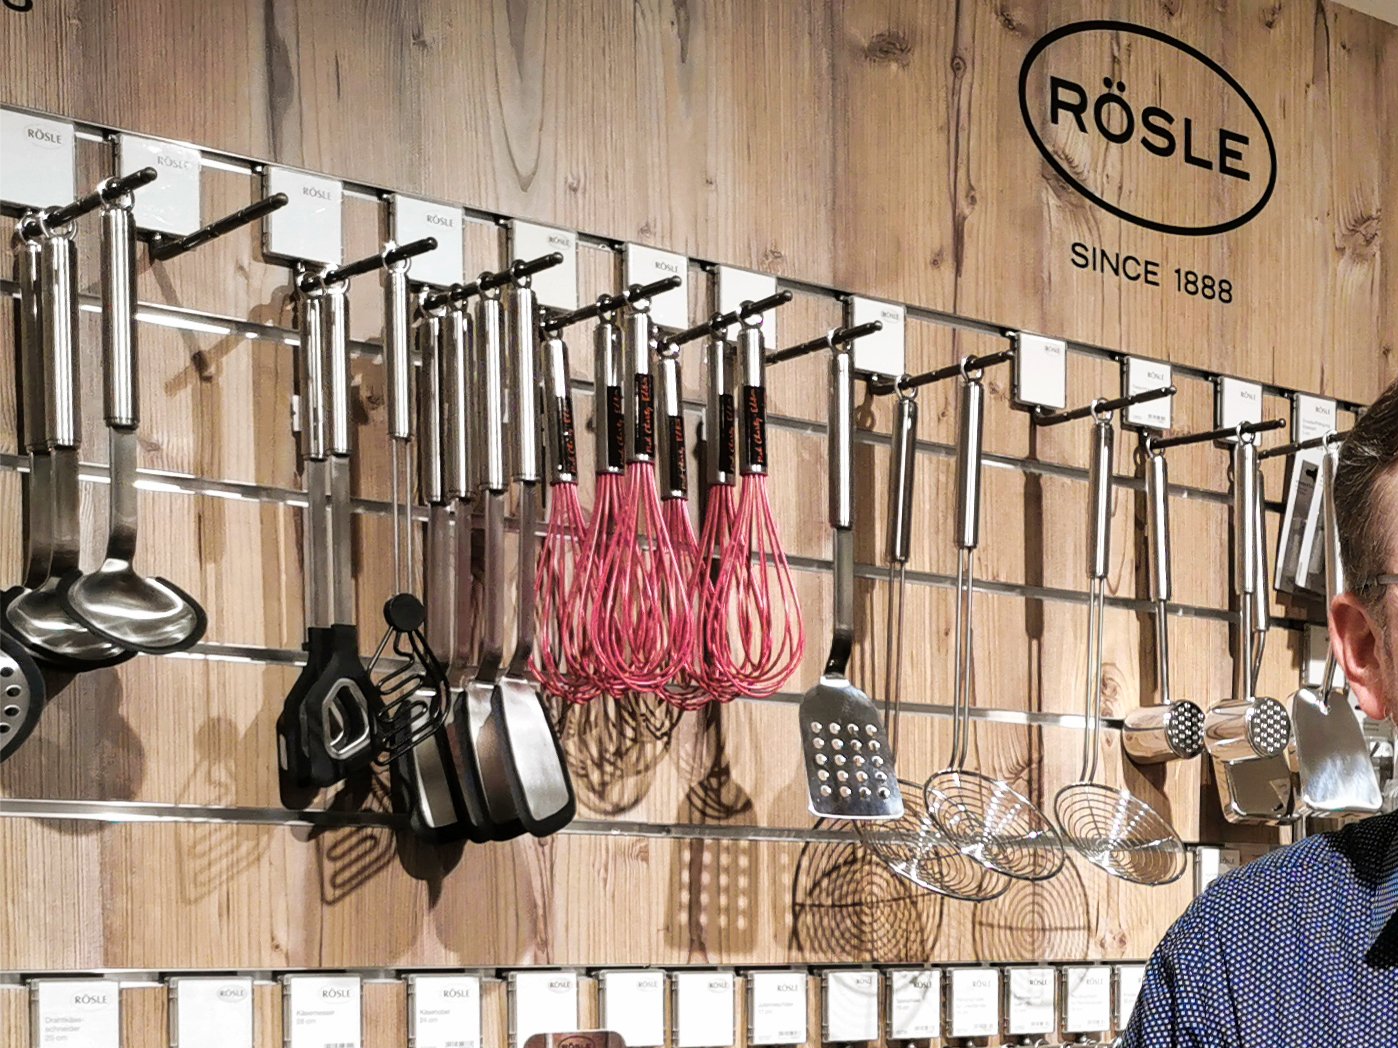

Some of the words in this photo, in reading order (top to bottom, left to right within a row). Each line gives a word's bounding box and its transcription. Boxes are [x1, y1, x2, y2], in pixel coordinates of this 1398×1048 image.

[1050, 75, 1251, 182] RÖSLE
[27, 127, 63, 145] RÖSLE
[302, 185, 332, 201] RÖSLE
[426, 214, 454, 228] RÖSLE
[1070, 241, 1160, 287] SINCE
[1174, 267, 1233, 304] 1888
[74, 993, 108, 1005] RÖSLE
[219, 988, 244, 998] RÖSLE
[322, 987, 350, 998] RÖSLE
[443, 988, 470, 998] RÖSLE
